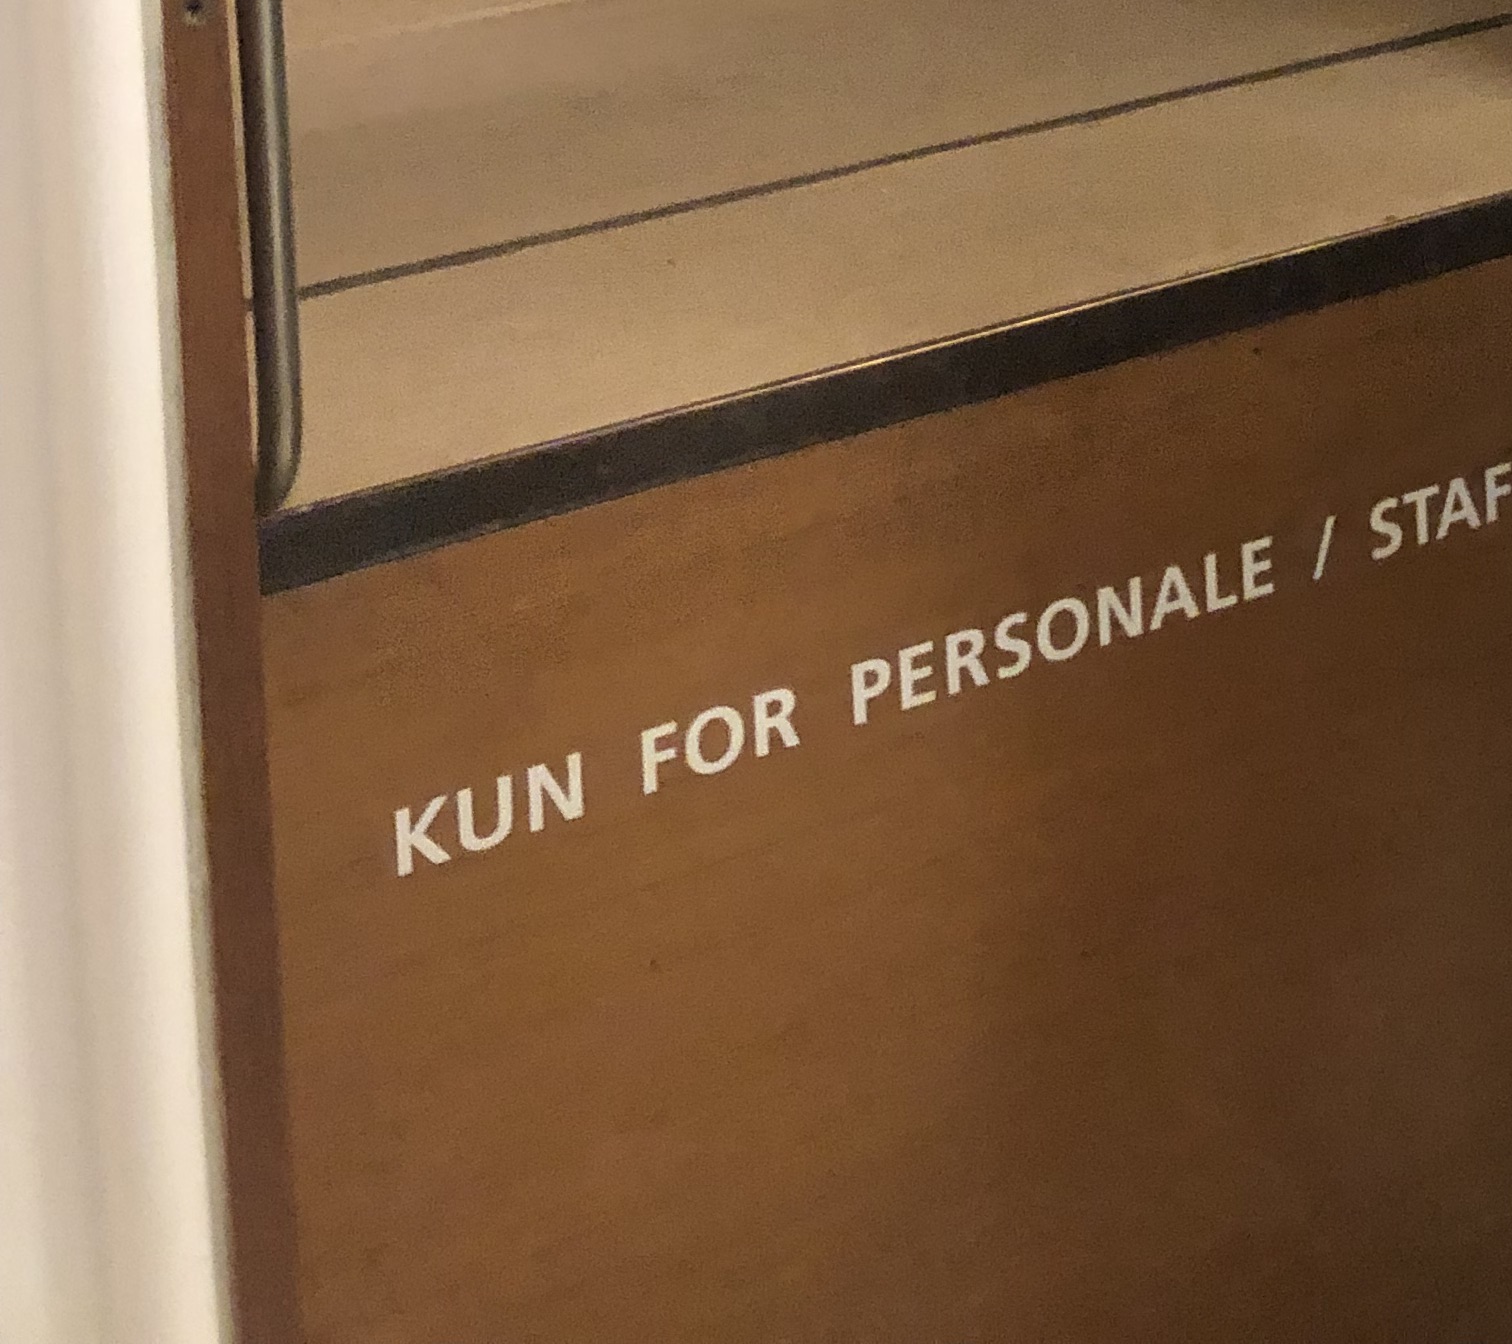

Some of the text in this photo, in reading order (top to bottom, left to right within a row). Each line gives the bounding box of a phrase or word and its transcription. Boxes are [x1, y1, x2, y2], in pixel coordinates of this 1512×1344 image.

[393, 752, 585, 878] KUN
[640, 687, 801, 796] FOR
[849, 534, 1277, 726] PERSONALE
[1312, 515, 1337, 581] /
